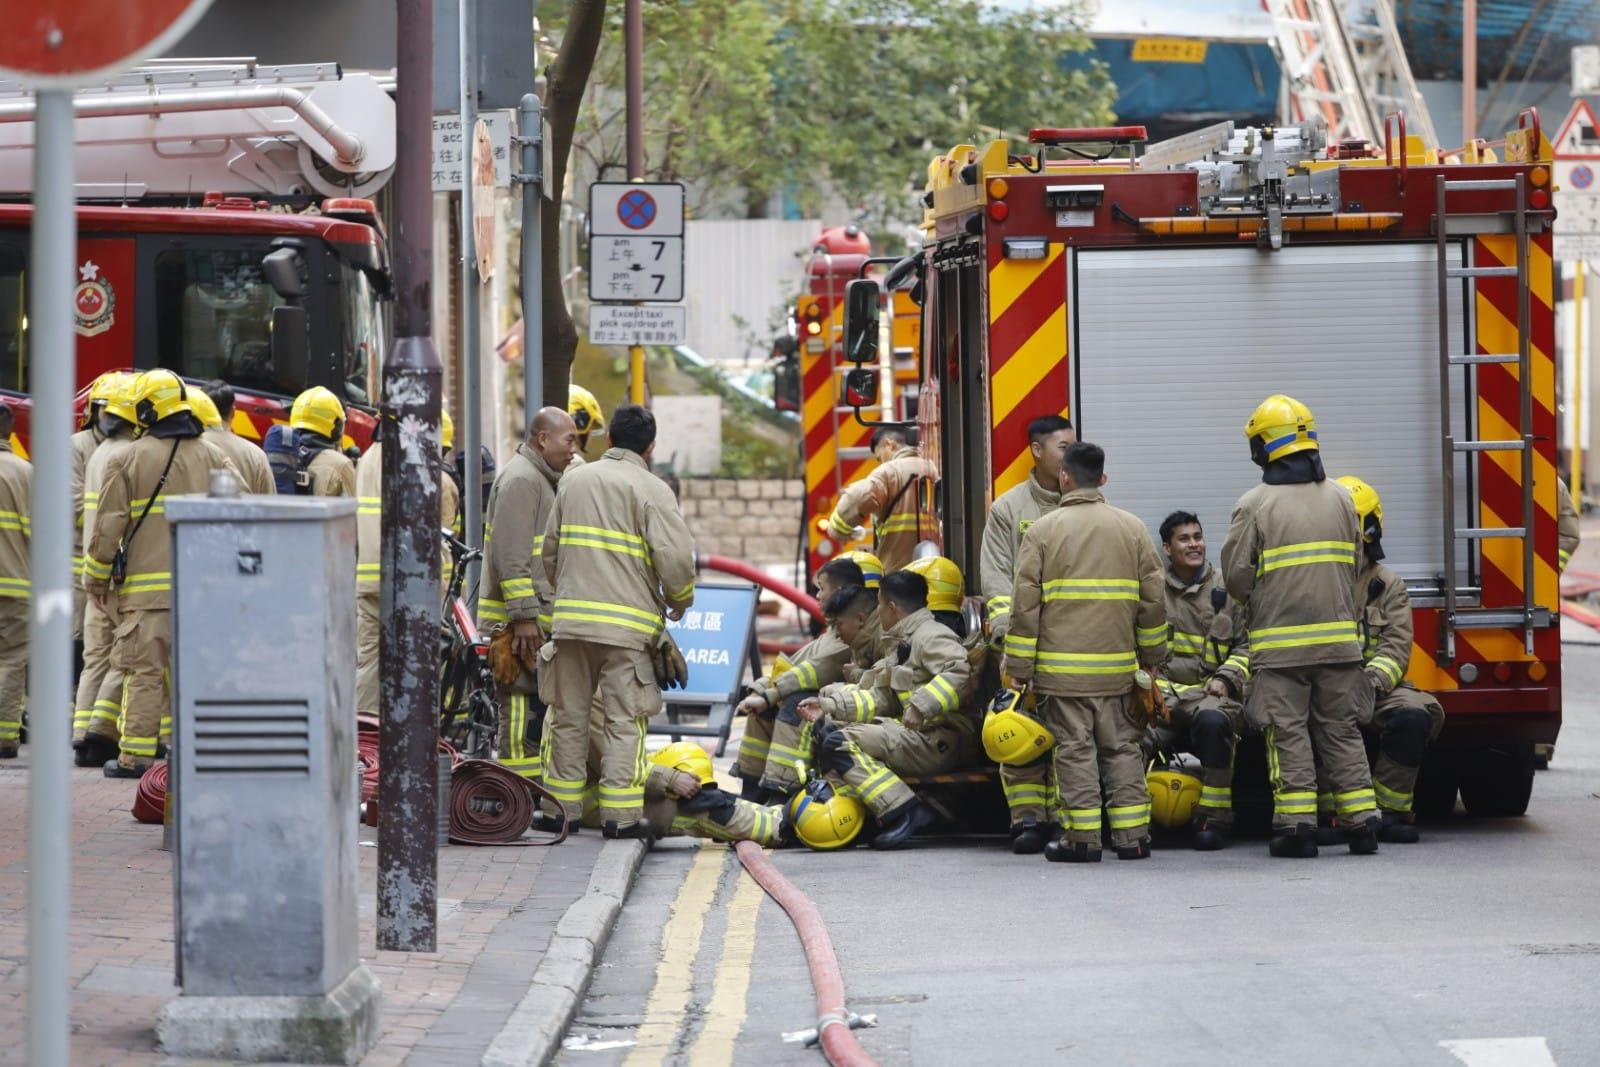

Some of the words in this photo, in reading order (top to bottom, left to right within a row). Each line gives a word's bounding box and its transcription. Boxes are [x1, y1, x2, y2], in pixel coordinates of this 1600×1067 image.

[433, 120, 462, 131] Exce
[608, 249, 635, 262] 上午
[651, 241, 666, 261] 7
[612, 272, 630, 281] pm
[608, 282, 634, 294] 下午
[651, 274, 665, 294] 7
[612, 309, 644, 318] Except
[646, 310, 664, 318] taxi
[600, 319, 618, 328] pick
[622, 320, 658, 329] up/drop
[661, 320, 674, 328] off
[685, 648, 729, 665] AREA
[998, 729, 1016, 743] TST
